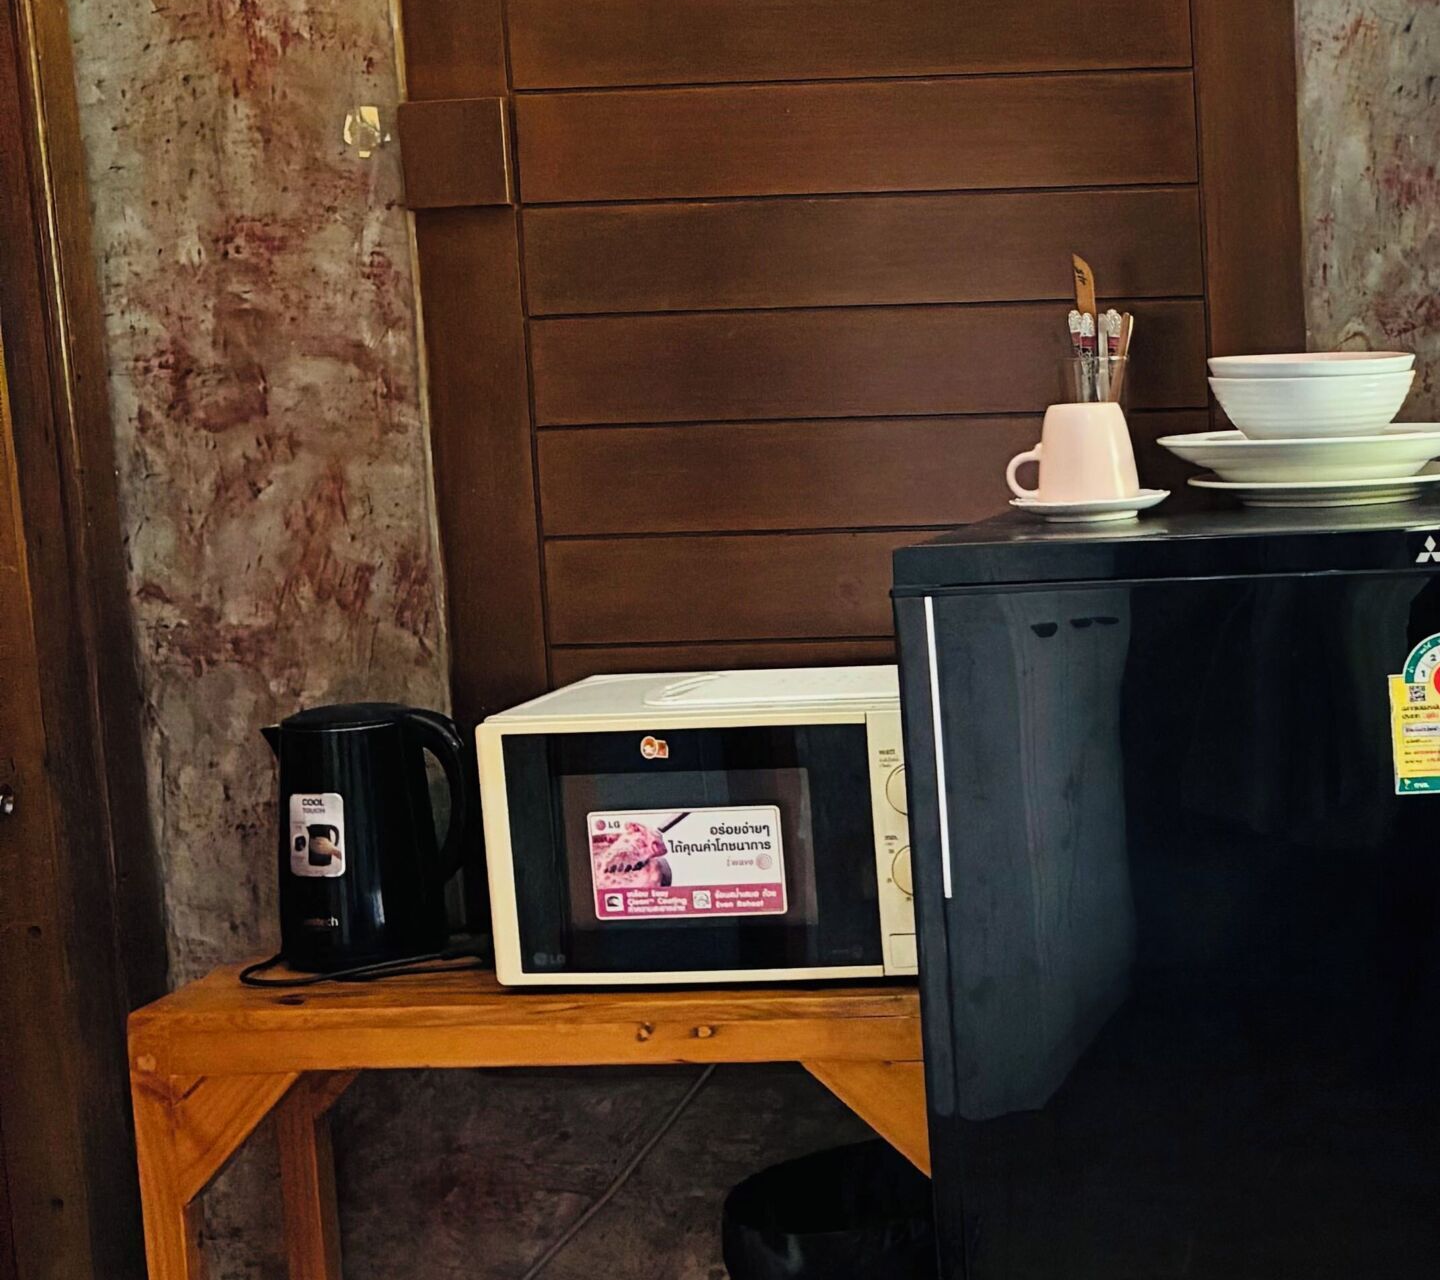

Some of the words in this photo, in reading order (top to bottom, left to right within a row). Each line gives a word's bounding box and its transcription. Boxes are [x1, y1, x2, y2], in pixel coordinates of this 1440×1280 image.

[1430, 654, 1437, 662] 2
[1421, 670, 1426, 678] 1
[302, 799, 325, 807] COOL
[302, 807, 326, 815] TOUCH
[608, 821, 621, 829] LG
